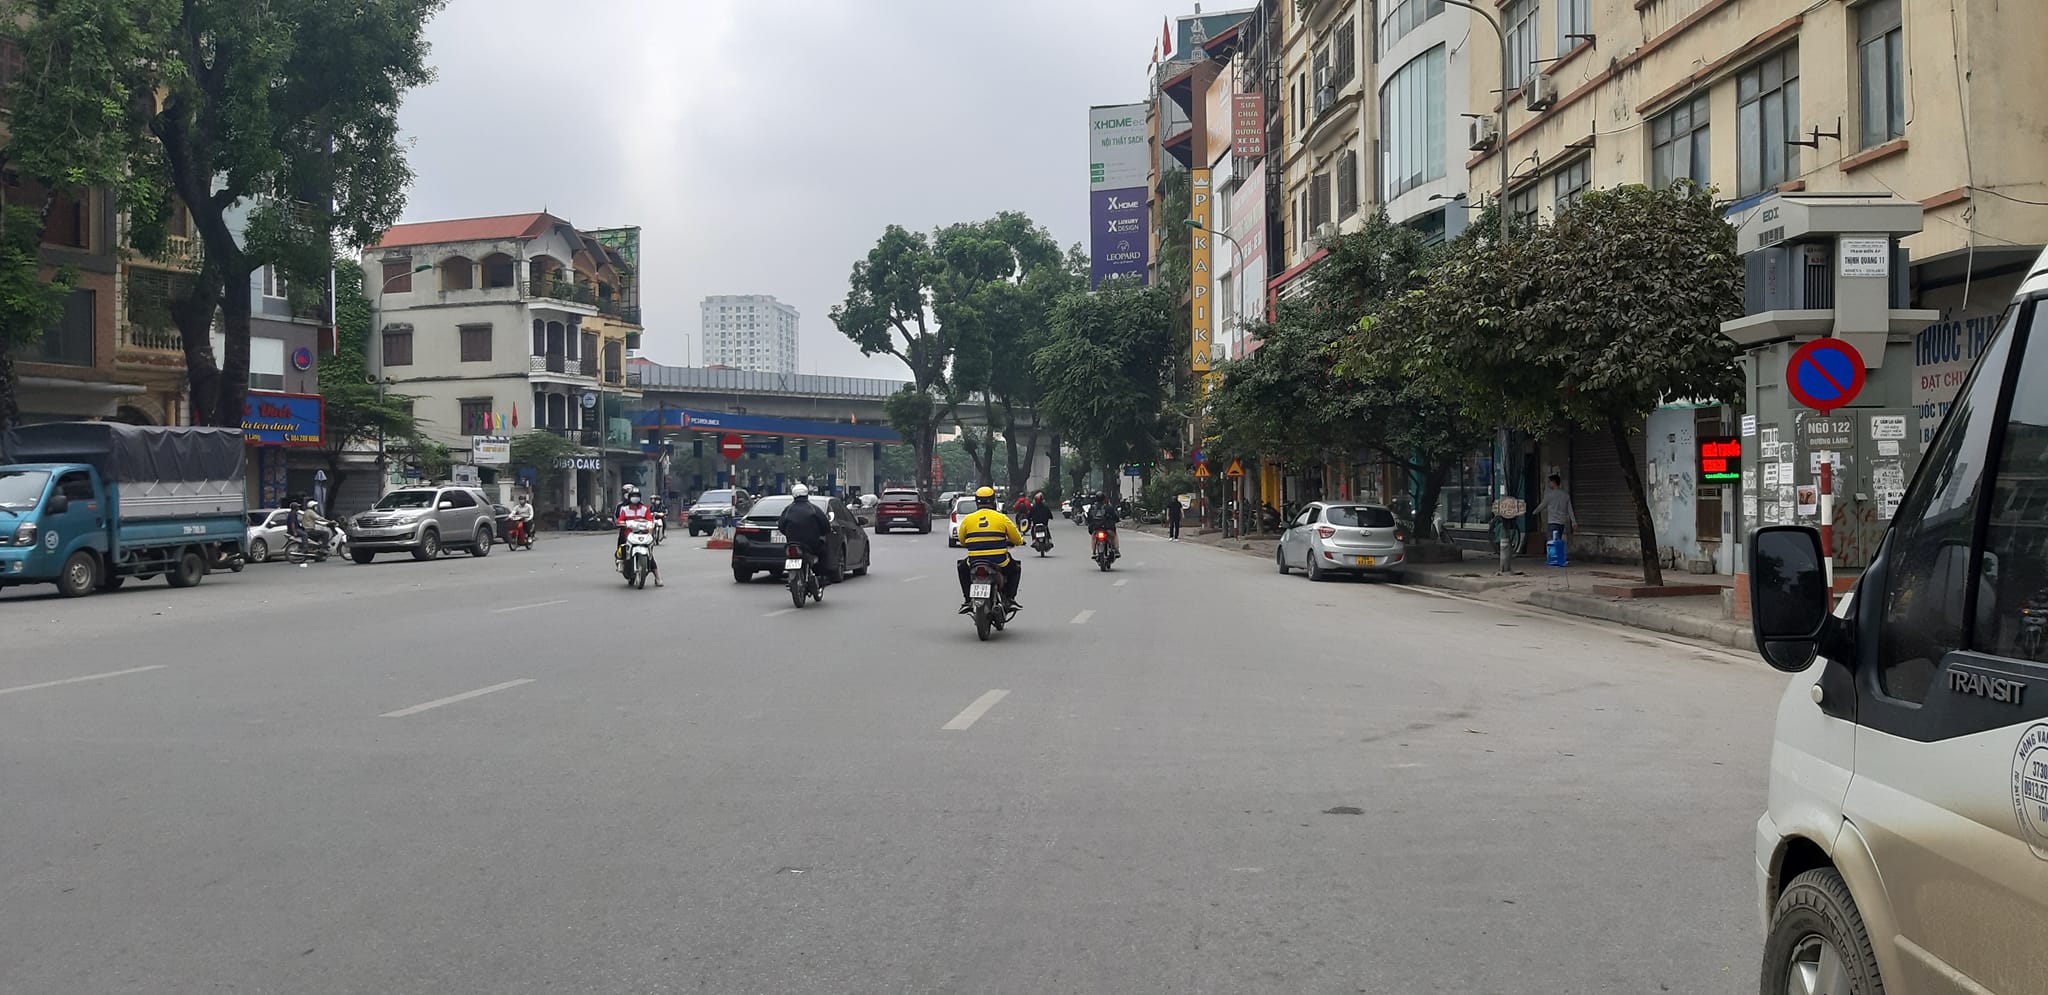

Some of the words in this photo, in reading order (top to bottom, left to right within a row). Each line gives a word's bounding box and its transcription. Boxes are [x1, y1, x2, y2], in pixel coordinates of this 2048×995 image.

[1762, 206, 1779, 223] EDI
[1118, 224, 1139, 232] DESIGN
[1106, 251, 1141, 261] LEOPARD
[1879, 256, 1885, 264] 11
[1915, 307, 1962, 367] THUỐC
[1921, 374, 1941, 392] ĐẠT
[1808, 419, 1829, 434] NGÕ
[1832, 421, 1850, 433] 122
[576, 458, 601, 470] CAKE
[1946, 668, 2026, 705] TRANSIT
